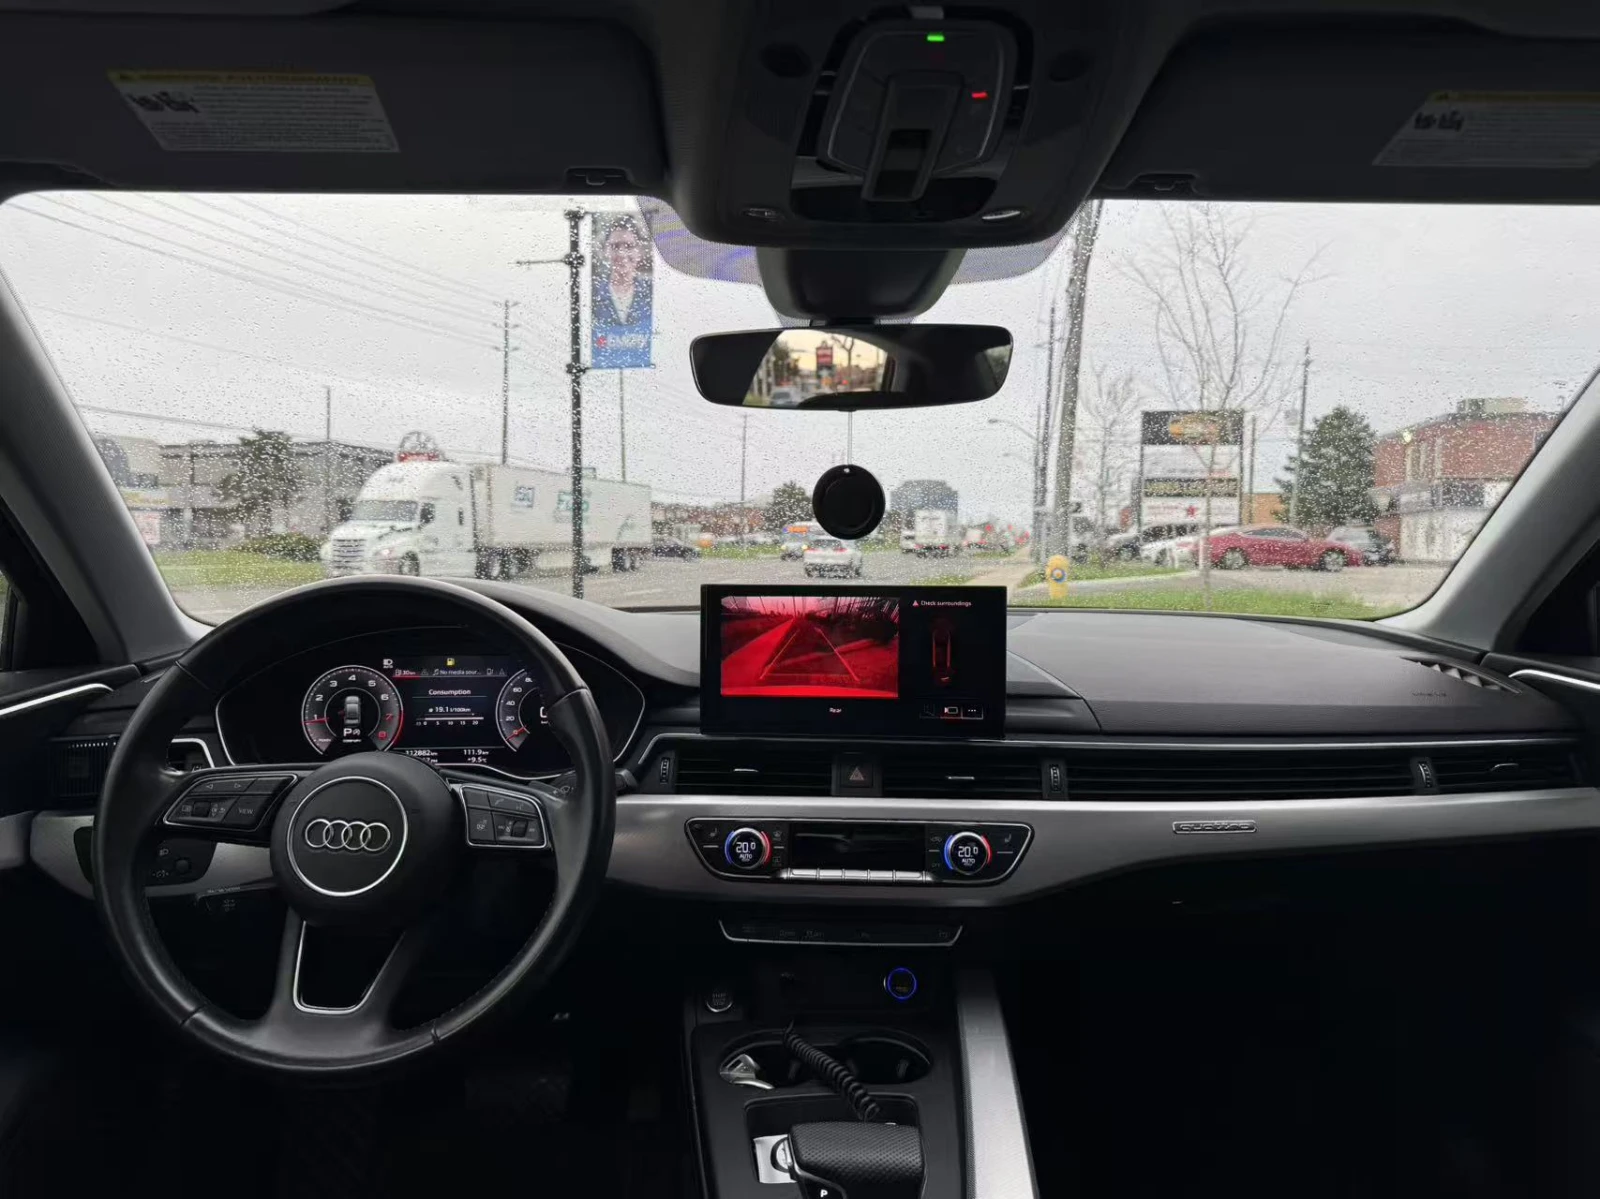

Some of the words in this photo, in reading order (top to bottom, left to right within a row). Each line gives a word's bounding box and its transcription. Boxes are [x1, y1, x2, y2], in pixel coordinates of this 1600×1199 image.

[428, 689, 471, 697] Consumption
[343, 728, 352, 737] P
[238, 807, 255, 815] VIEW
[820, 1189, 828, 1198] P
